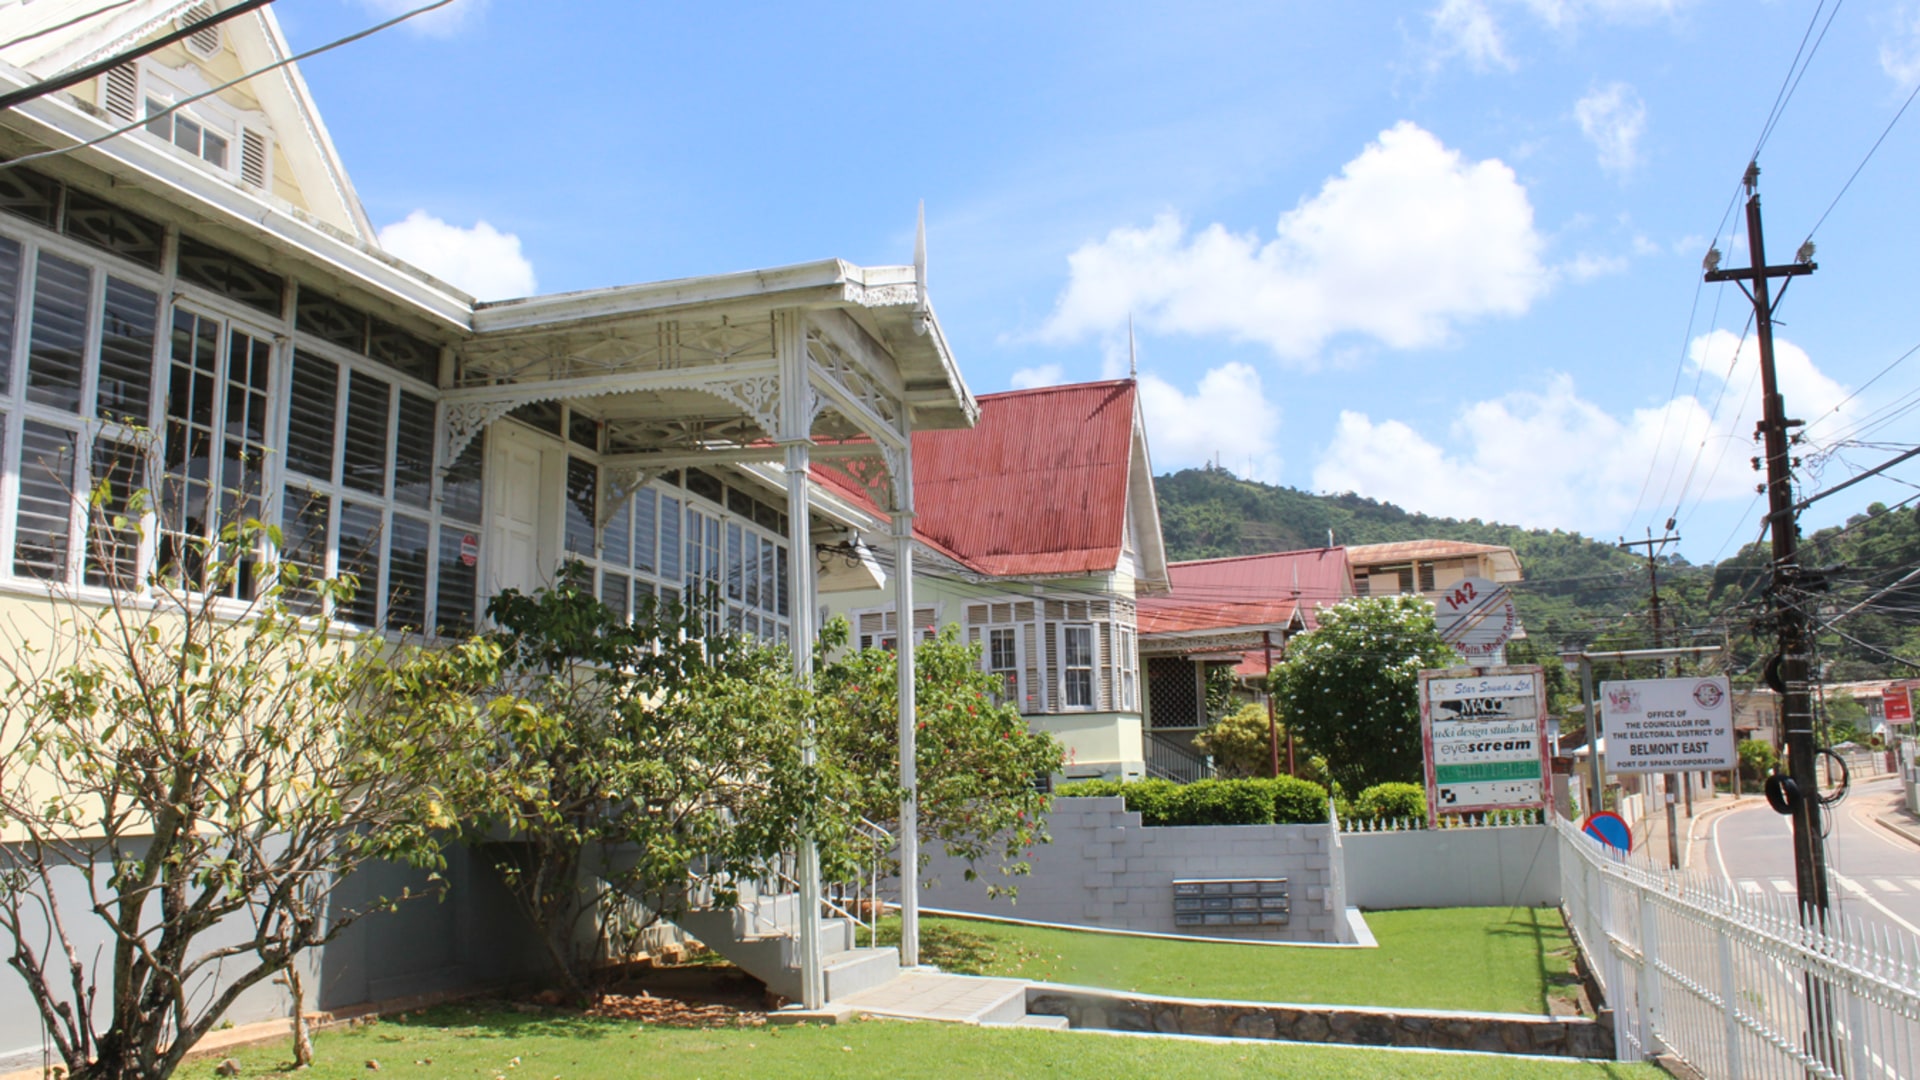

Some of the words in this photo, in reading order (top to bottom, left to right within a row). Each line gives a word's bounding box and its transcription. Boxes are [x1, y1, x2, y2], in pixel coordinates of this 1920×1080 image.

[1446, 582, 1478, 610] 142
[1454, 683, 1476, 694] Star
[1479, 681, 1512, 693] Sounds
[1513, 680, 1531, 691] Ltd
[1676, 710, 1687, 718] OF
[1643, 720, 1694, 729] COUNCILLOR
[1695, 719, 1711, 727] FOR
[1456, 726, 1488, 739] design
[1490, 724, 1519, 734] studio
[1630, 730, 1675, 739] ELECTORAL
[1677, 728, 1712, 737] DISTRICT
[1714, 728, 1725, 736] OF
[1441, 740, 1530, 756] eyescream
[1630, 743, 1680, 756] BELMONT
[1682, 742, 1709, 754] EAST
[1650, 759, 1671, 767] SPAIN
[1672, 758, 1725, 766] CORPORATION
